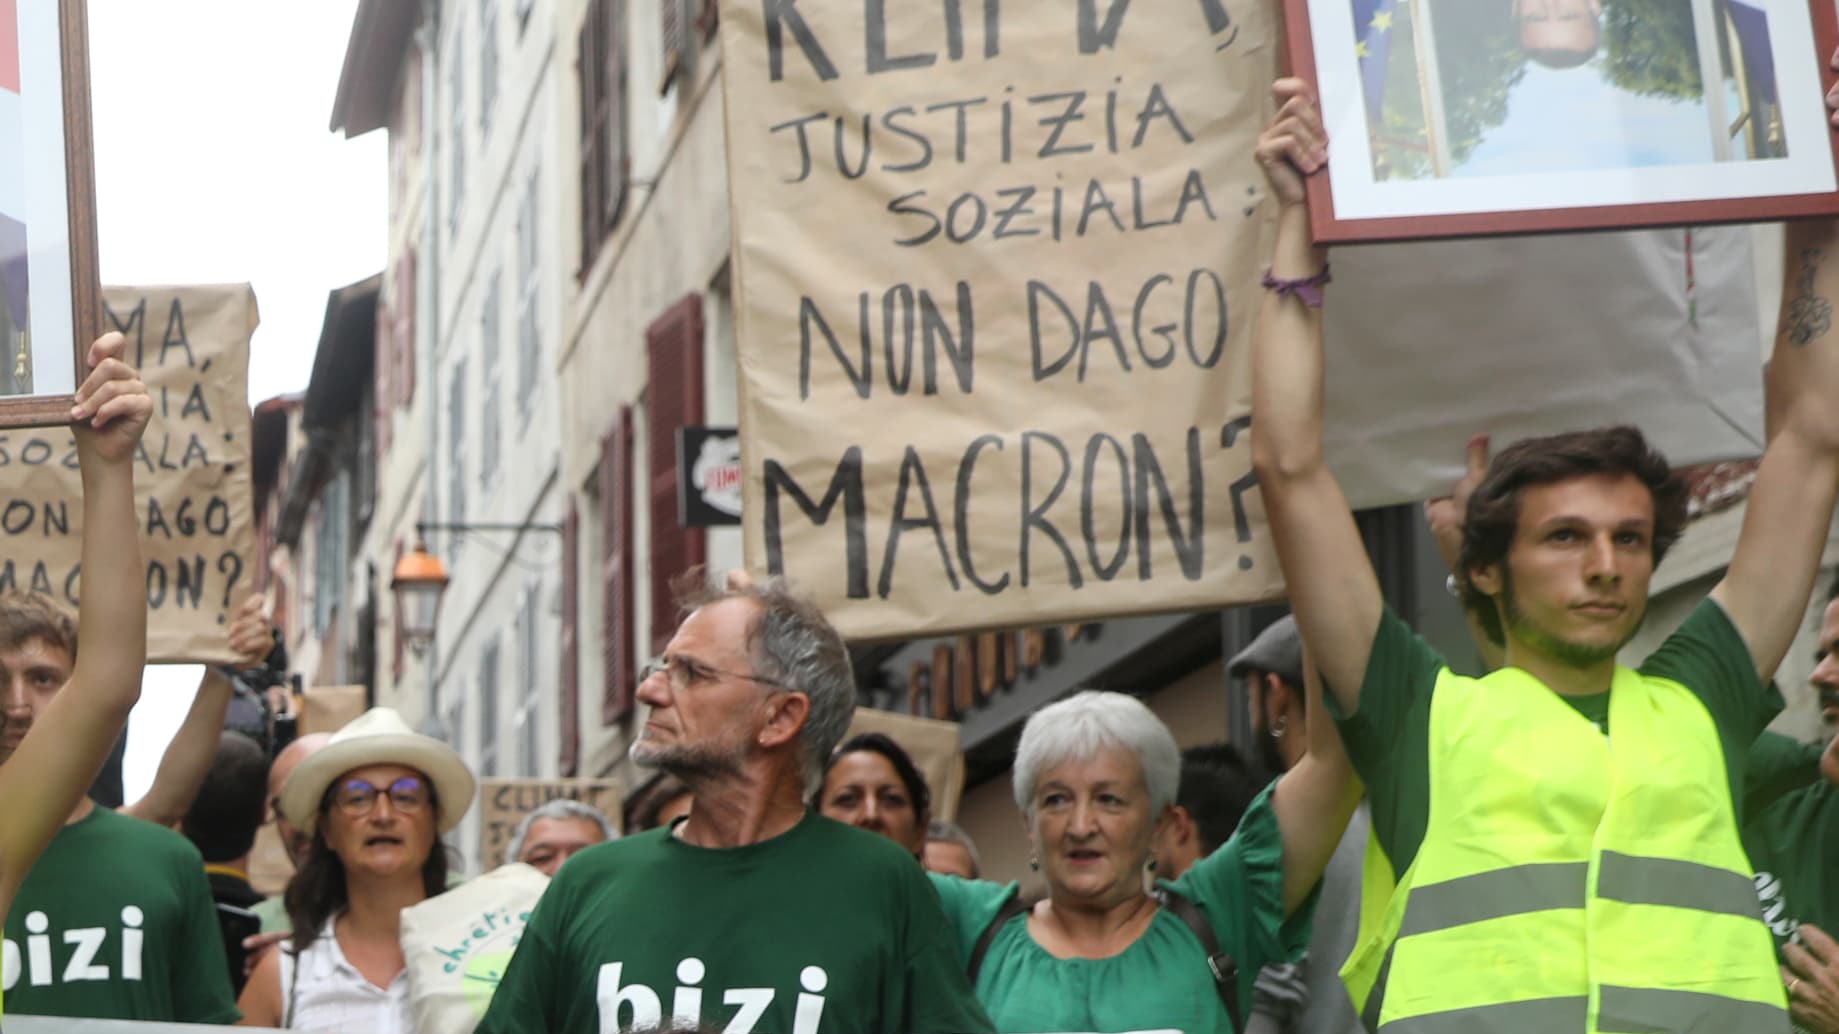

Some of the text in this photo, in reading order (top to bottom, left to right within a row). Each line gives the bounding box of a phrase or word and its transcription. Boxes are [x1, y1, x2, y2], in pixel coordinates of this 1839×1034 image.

[770, 77, 1195, 184] JUSTIZIA
[799, 269, 1228, 400] NON DAGO
[137, 496, 231, 540] AGO
